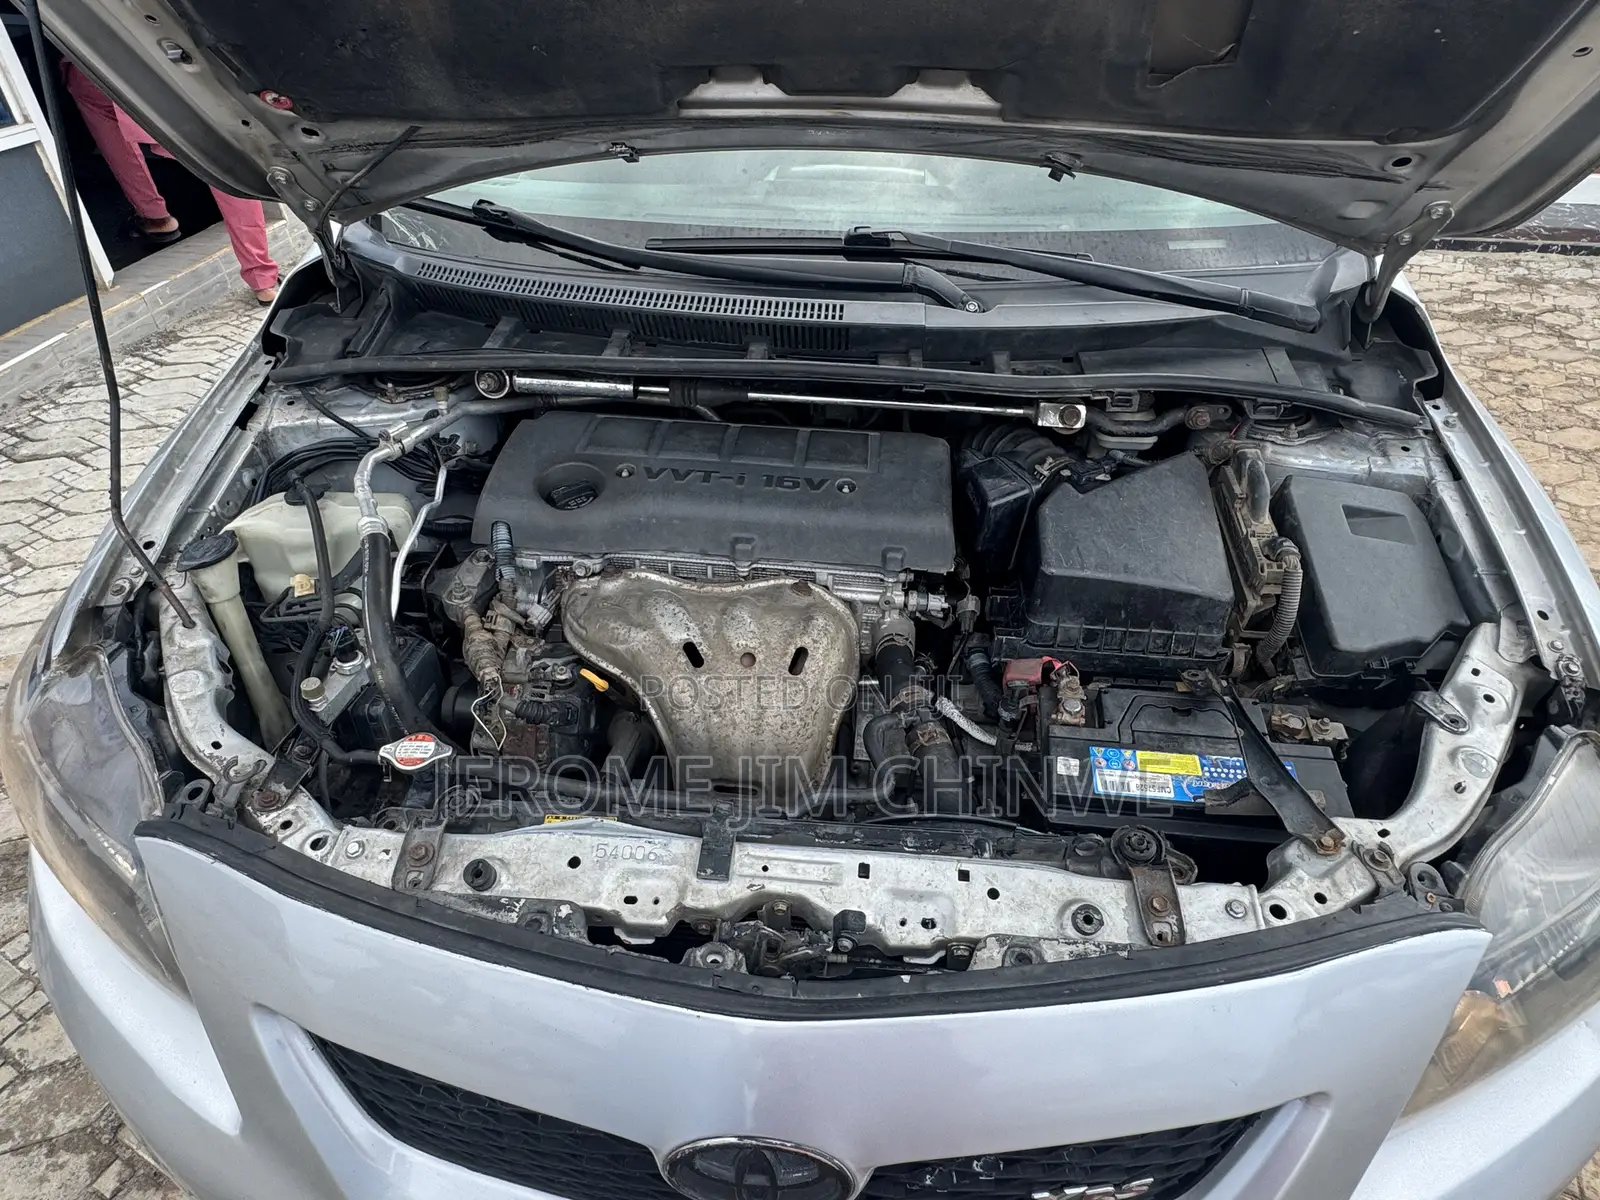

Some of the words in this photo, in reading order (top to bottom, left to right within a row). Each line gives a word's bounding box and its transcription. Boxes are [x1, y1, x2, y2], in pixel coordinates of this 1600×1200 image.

[643, 465, 746, 488] VVT-i
[761, 473, 832, 494] 16V
[595, 842, 661, 862] 54006
